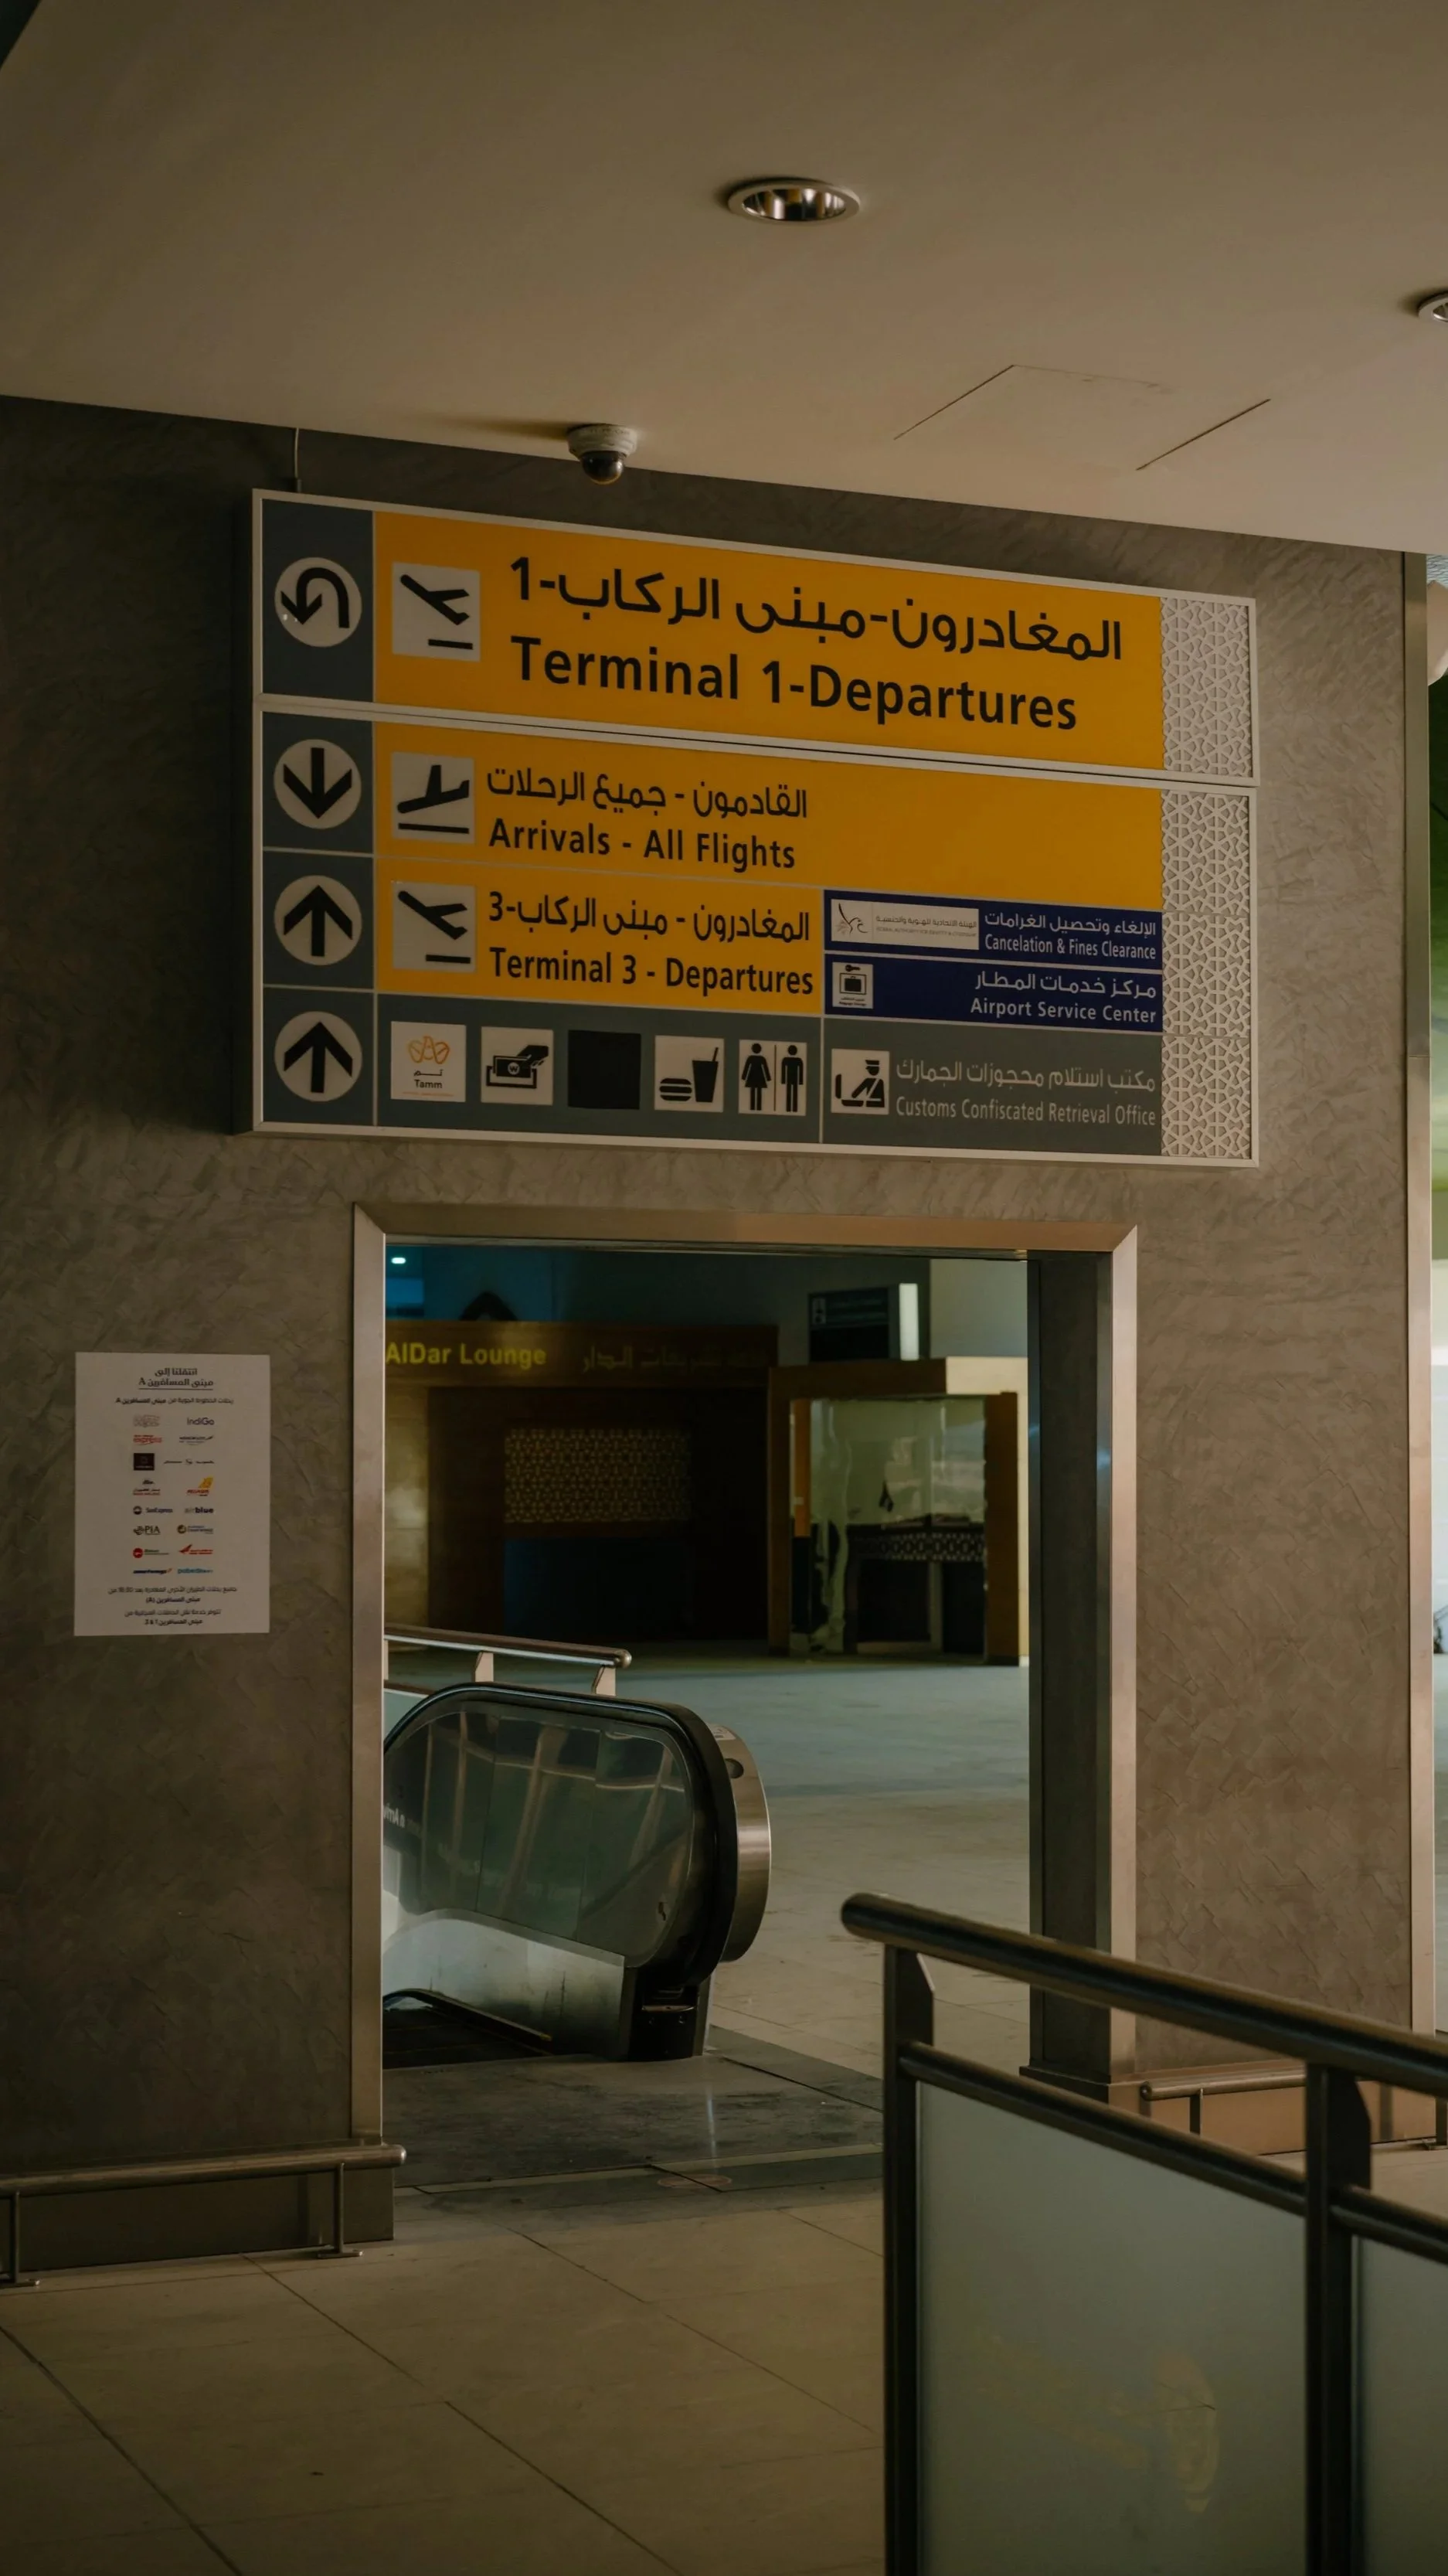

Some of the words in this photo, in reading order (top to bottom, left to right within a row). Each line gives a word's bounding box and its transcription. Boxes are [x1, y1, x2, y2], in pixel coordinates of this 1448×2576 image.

[736, 587, 1120, 662] المغادرون-مبنى
[511, 635, 737, 699] Terminal
[763, 661, 1076, 730] 1-Departures
[488, 767, 584, 806] الرحلات
[593, 774, 666, 816] جميع
[693, 781, 807, 818] القادمون
[489, 818, 610, 855] Arrivals
[644, 829, 682, 860] All
[698, 832, 794, 873] Flights
[603, 900, 668, 940] مبنى
[694, 905, 808, 943] المغادرون
[985, 913, 1045, 930] الغرامات
[1049, 917, 1110, 935] وتحصيل
[985, 934, 1052, 952] Cancelation
[1057, 938, 1065, 954] &
[1069, 938, 1098, 955] Fines
[1102, 941, 1156, 959] Clearance
[489, 947, 610, 982] Terminal
[623, 955, 636, 984] 3
[667, 958, 813, 996] Departures
[975, 971, 1035, 990] المطار
[1041, 975, 1105, 993] خدمات
[1110, 978, 1156, 999] مركز
[970, 998, 1032, 1018] Airport
[1038, 1002, 1096, 1019] Service
[1103, 1005, 1156, 1023] Center
[414, 1079, 442, 1088] Tamm
[896, 1060, 962, 1084] الجمارك
[967, 1063, 1044, 1089] محجوزات
[1049, 1067, 1103, 1089] استلام
[1108, 1070, 1155, 1094] مكتب
[896, 1096, 956, 1118] Customs
[962, 1098, 1043, 1121] Confiscated
[1049, 1103, 1110, 1123] Retrieval
[1115, 1104, 1155, 1125] Office
[460, 1342, 547, 1370] Lounge
[138, 1377, 146, 1386] A
[186, 1417, 215, 1425] IndiGo
